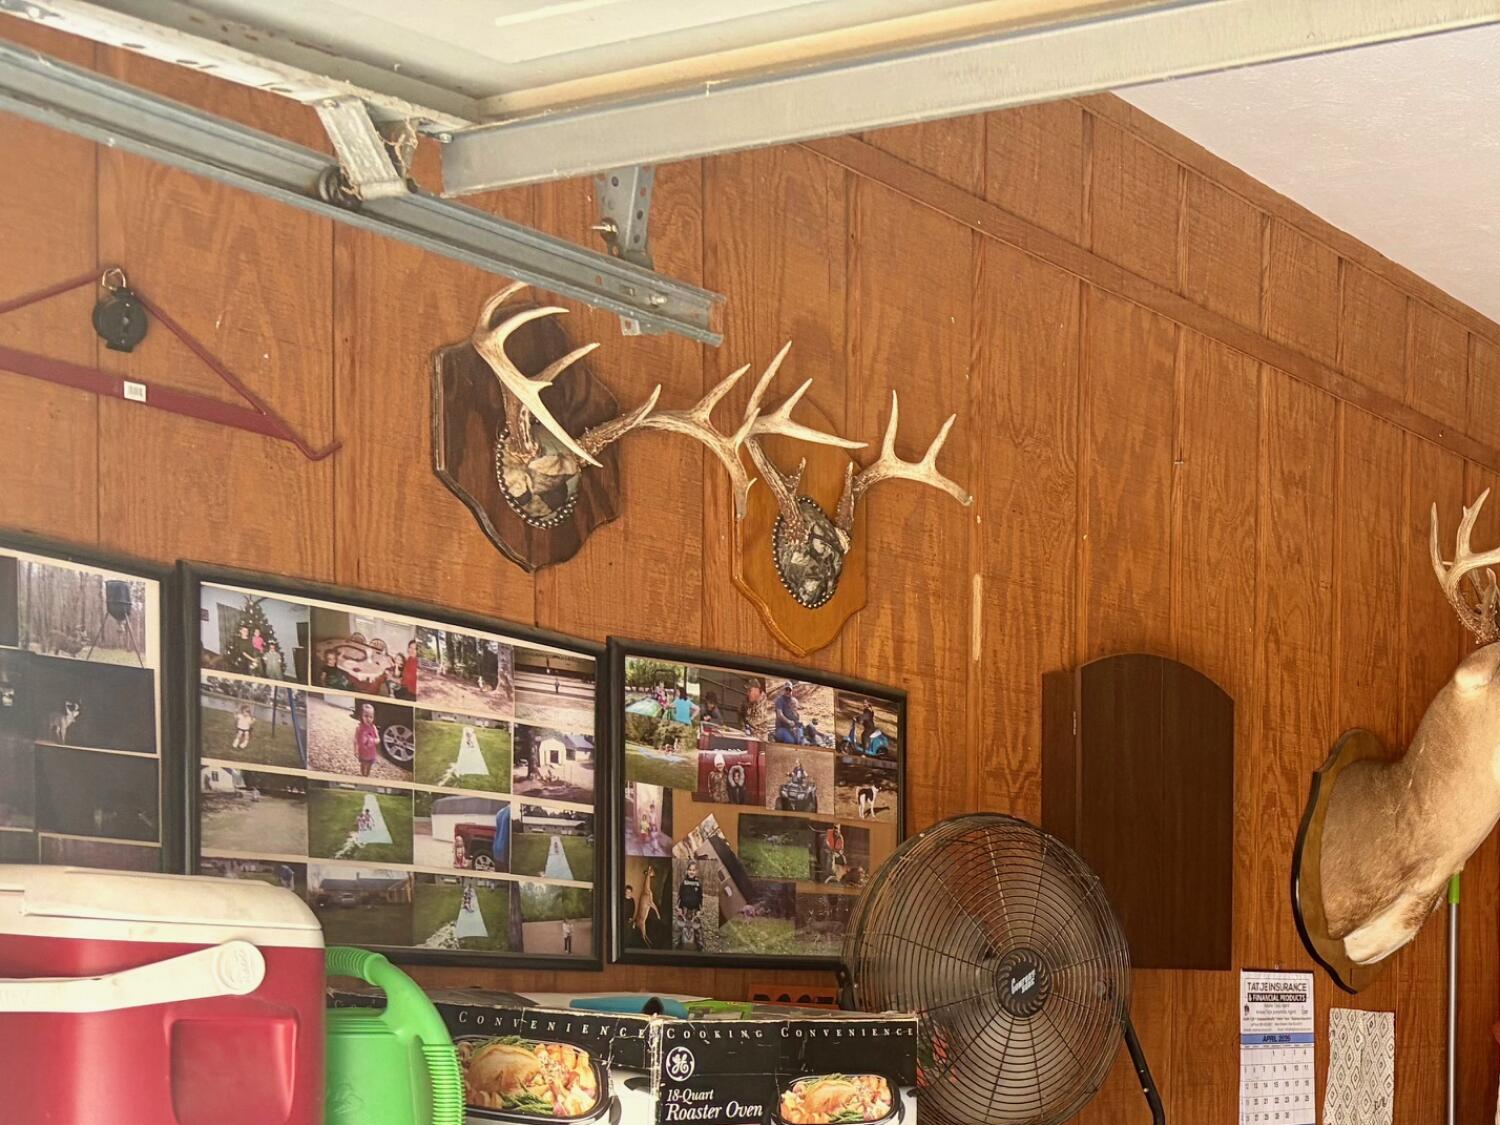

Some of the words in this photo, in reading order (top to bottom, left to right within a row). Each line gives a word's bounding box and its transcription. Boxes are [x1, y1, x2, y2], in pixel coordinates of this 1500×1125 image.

[1269, 982, 1307, 992] INSURANCE
[459, 1011, 645, 1039] CONVENIENCE
[667, 1028, 763, 1039] COOKING
[781, 1026, 913, 1037] CONVENIENCE
[1263, 1035, 1277, 1043] APRIL
[667, 1088, 714, 1104] 18-Quart
[665, 1103, 722, 1120] Roaster
[726, 1100, 763, 1118] Oven
